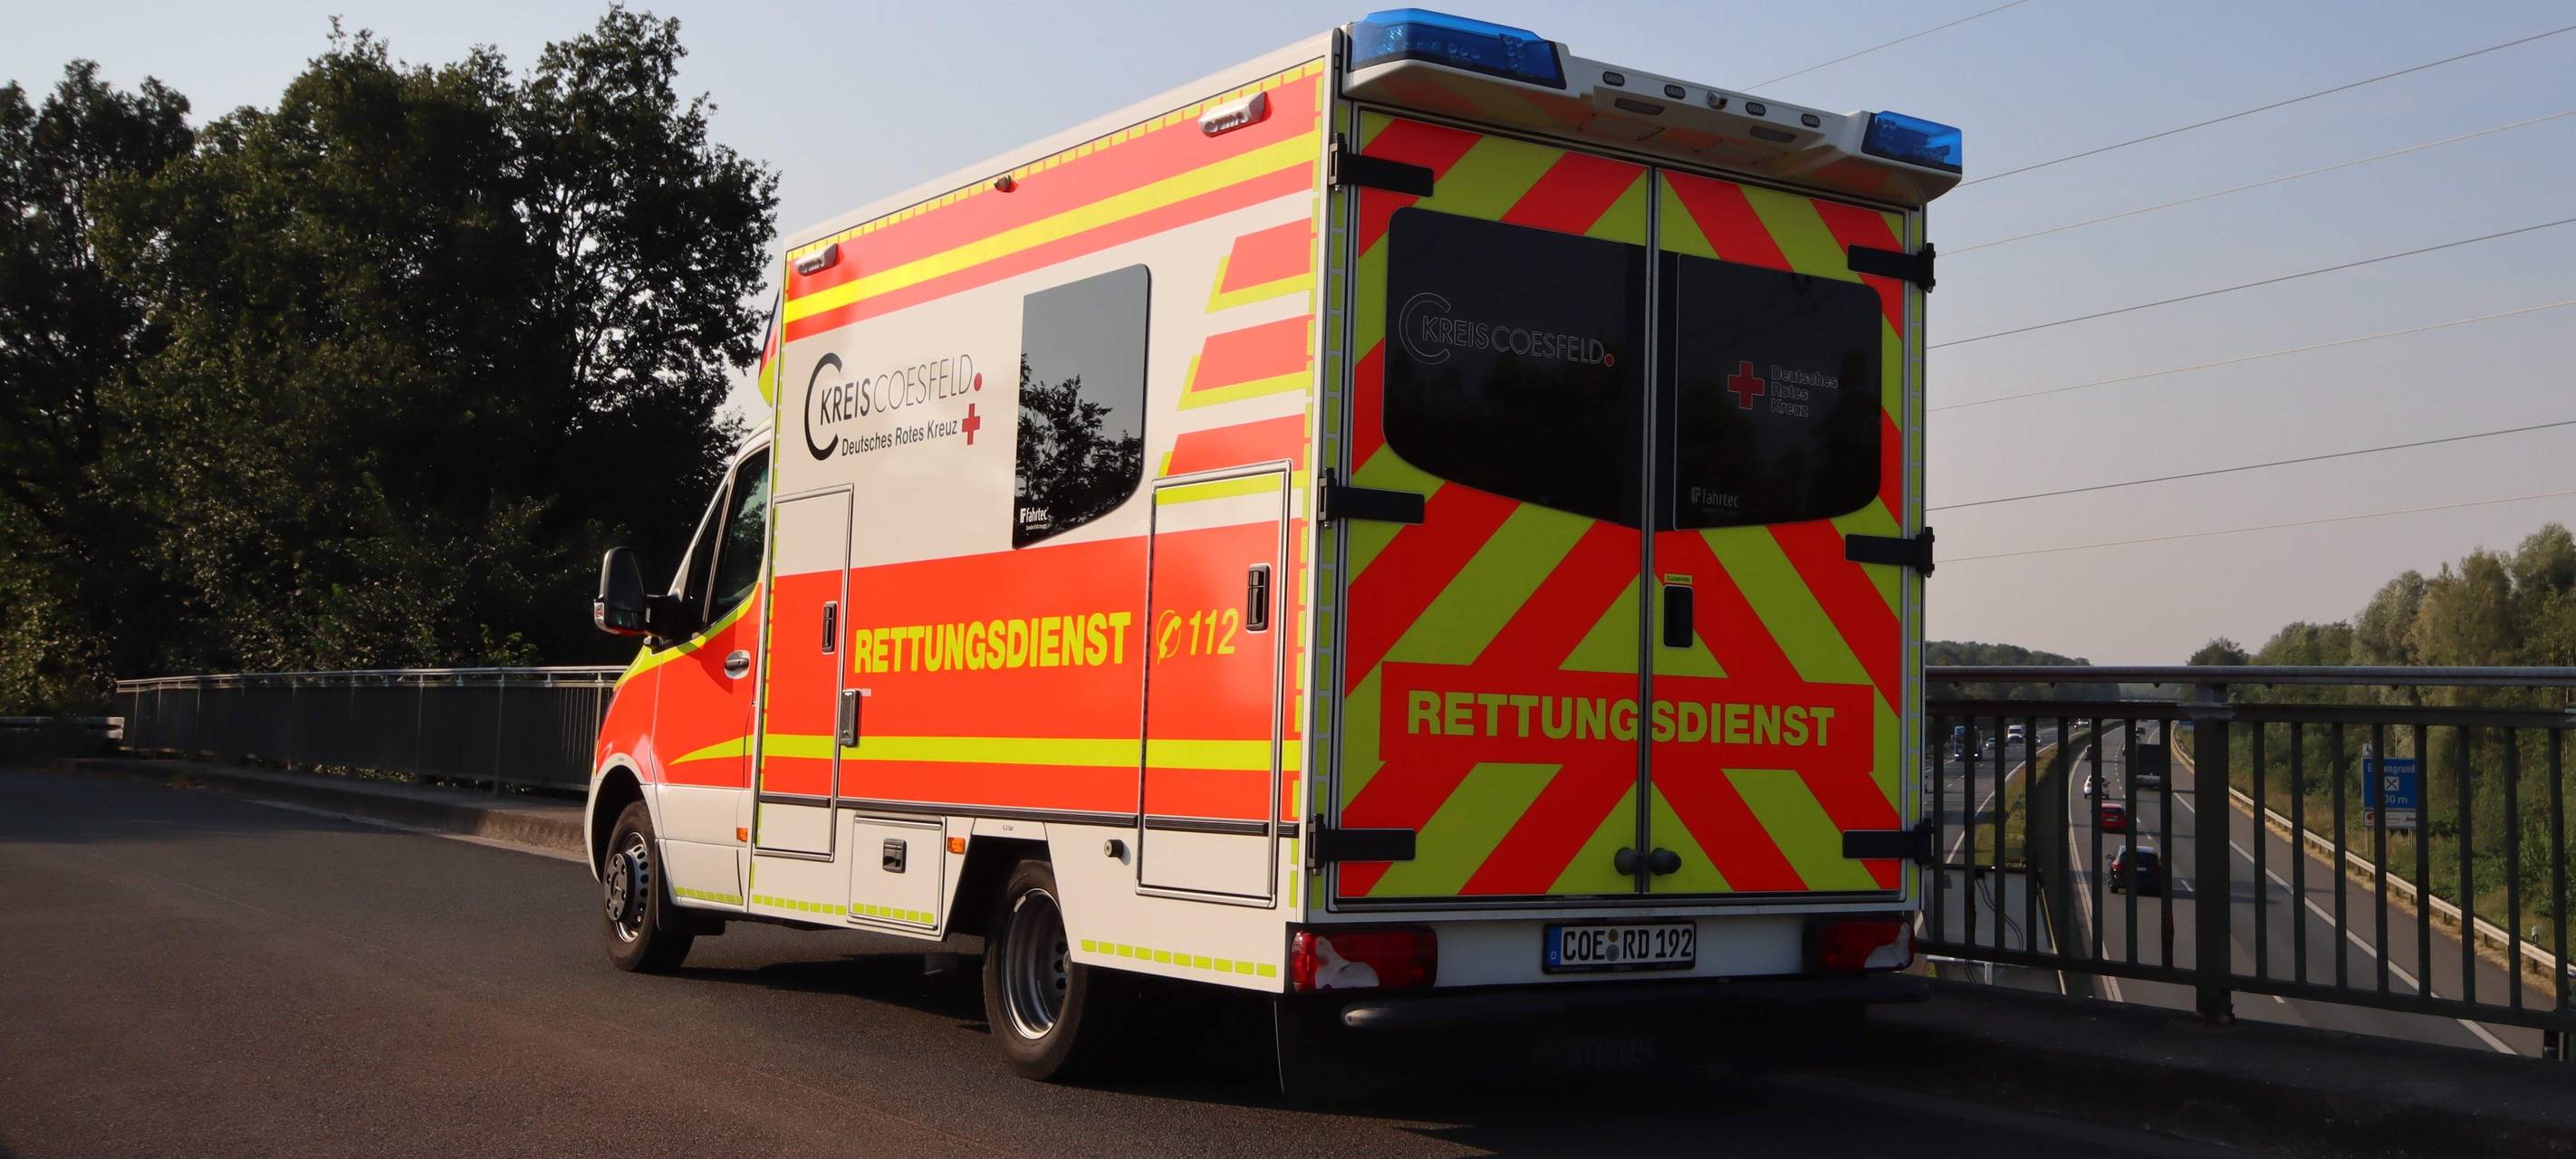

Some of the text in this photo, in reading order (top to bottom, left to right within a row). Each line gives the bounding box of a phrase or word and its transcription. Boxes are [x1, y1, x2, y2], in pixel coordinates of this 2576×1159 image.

[1421, 314, 1490, 350] KREIS
[1770, 364, 1839, 388] Deutsches
[1770, 381, 1810, 401] Rotes
[820, 378, 870, 426] KREIS
[1770, 398, 1810, 417] Kreuz
[841, 419, 957, 456] Deutsches Rotes Kreuz
[1025, 506, 1048, 522] fahrtec
[1702, 487, 1740, 508] fahrtec
[853, 608, 1240, 675] RETTUNGSDIENST 112
[1407, 689, 1835, 747] RETTUNGSDIENST
[1562, 929, 1606, 961] COE
[1622, 929, 1649, 960] RD
[1655, 928, 1693, 958] 192
